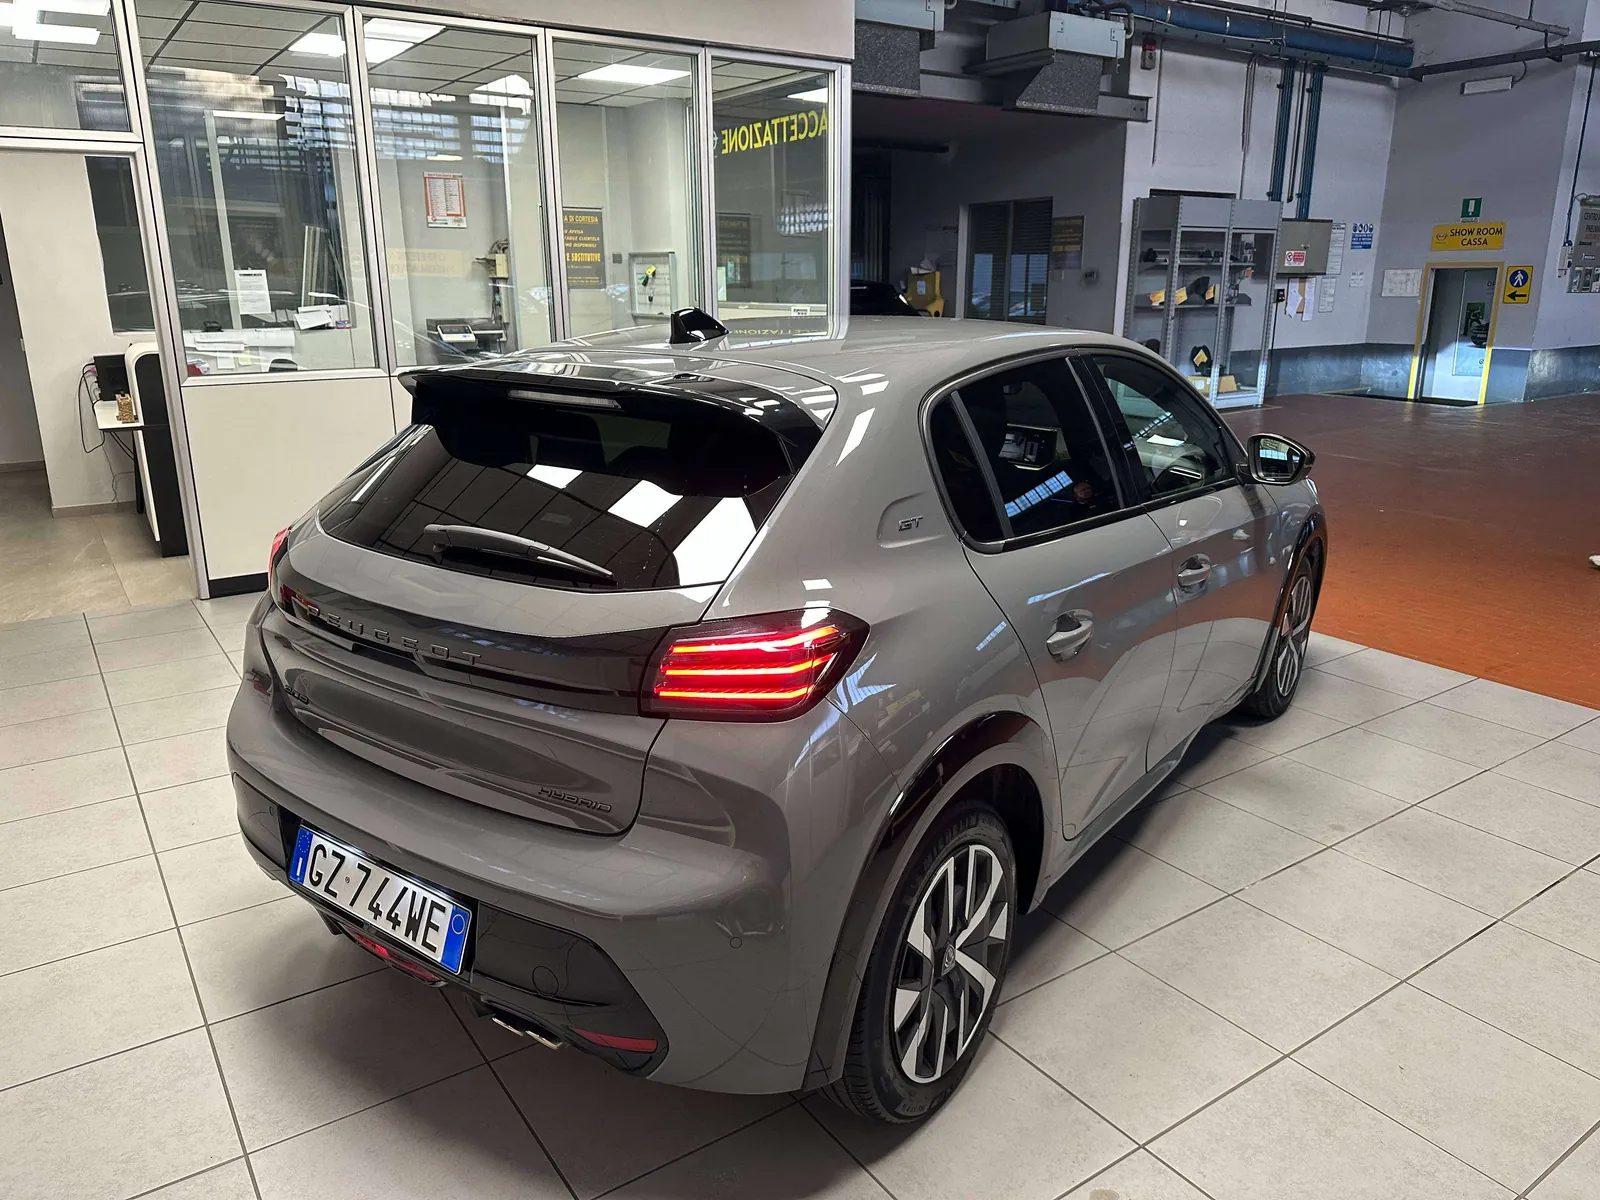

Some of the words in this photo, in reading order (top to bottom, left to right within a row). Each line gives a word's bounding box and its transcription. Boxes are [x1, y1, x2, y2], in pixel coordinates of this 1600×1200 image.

[1450, 228, 1475, 237] SHOW
[1476, 227, 1503, 236] ROOM
[1461, 238, 1488, 246] CASSA
[571, 252, 601, 262] SOSTITUTIVE
[898, 515, 924, 531] GT
[307, 604, 482, 666] PEUGEOT
[538, 786, 612, 813] HYBRID
